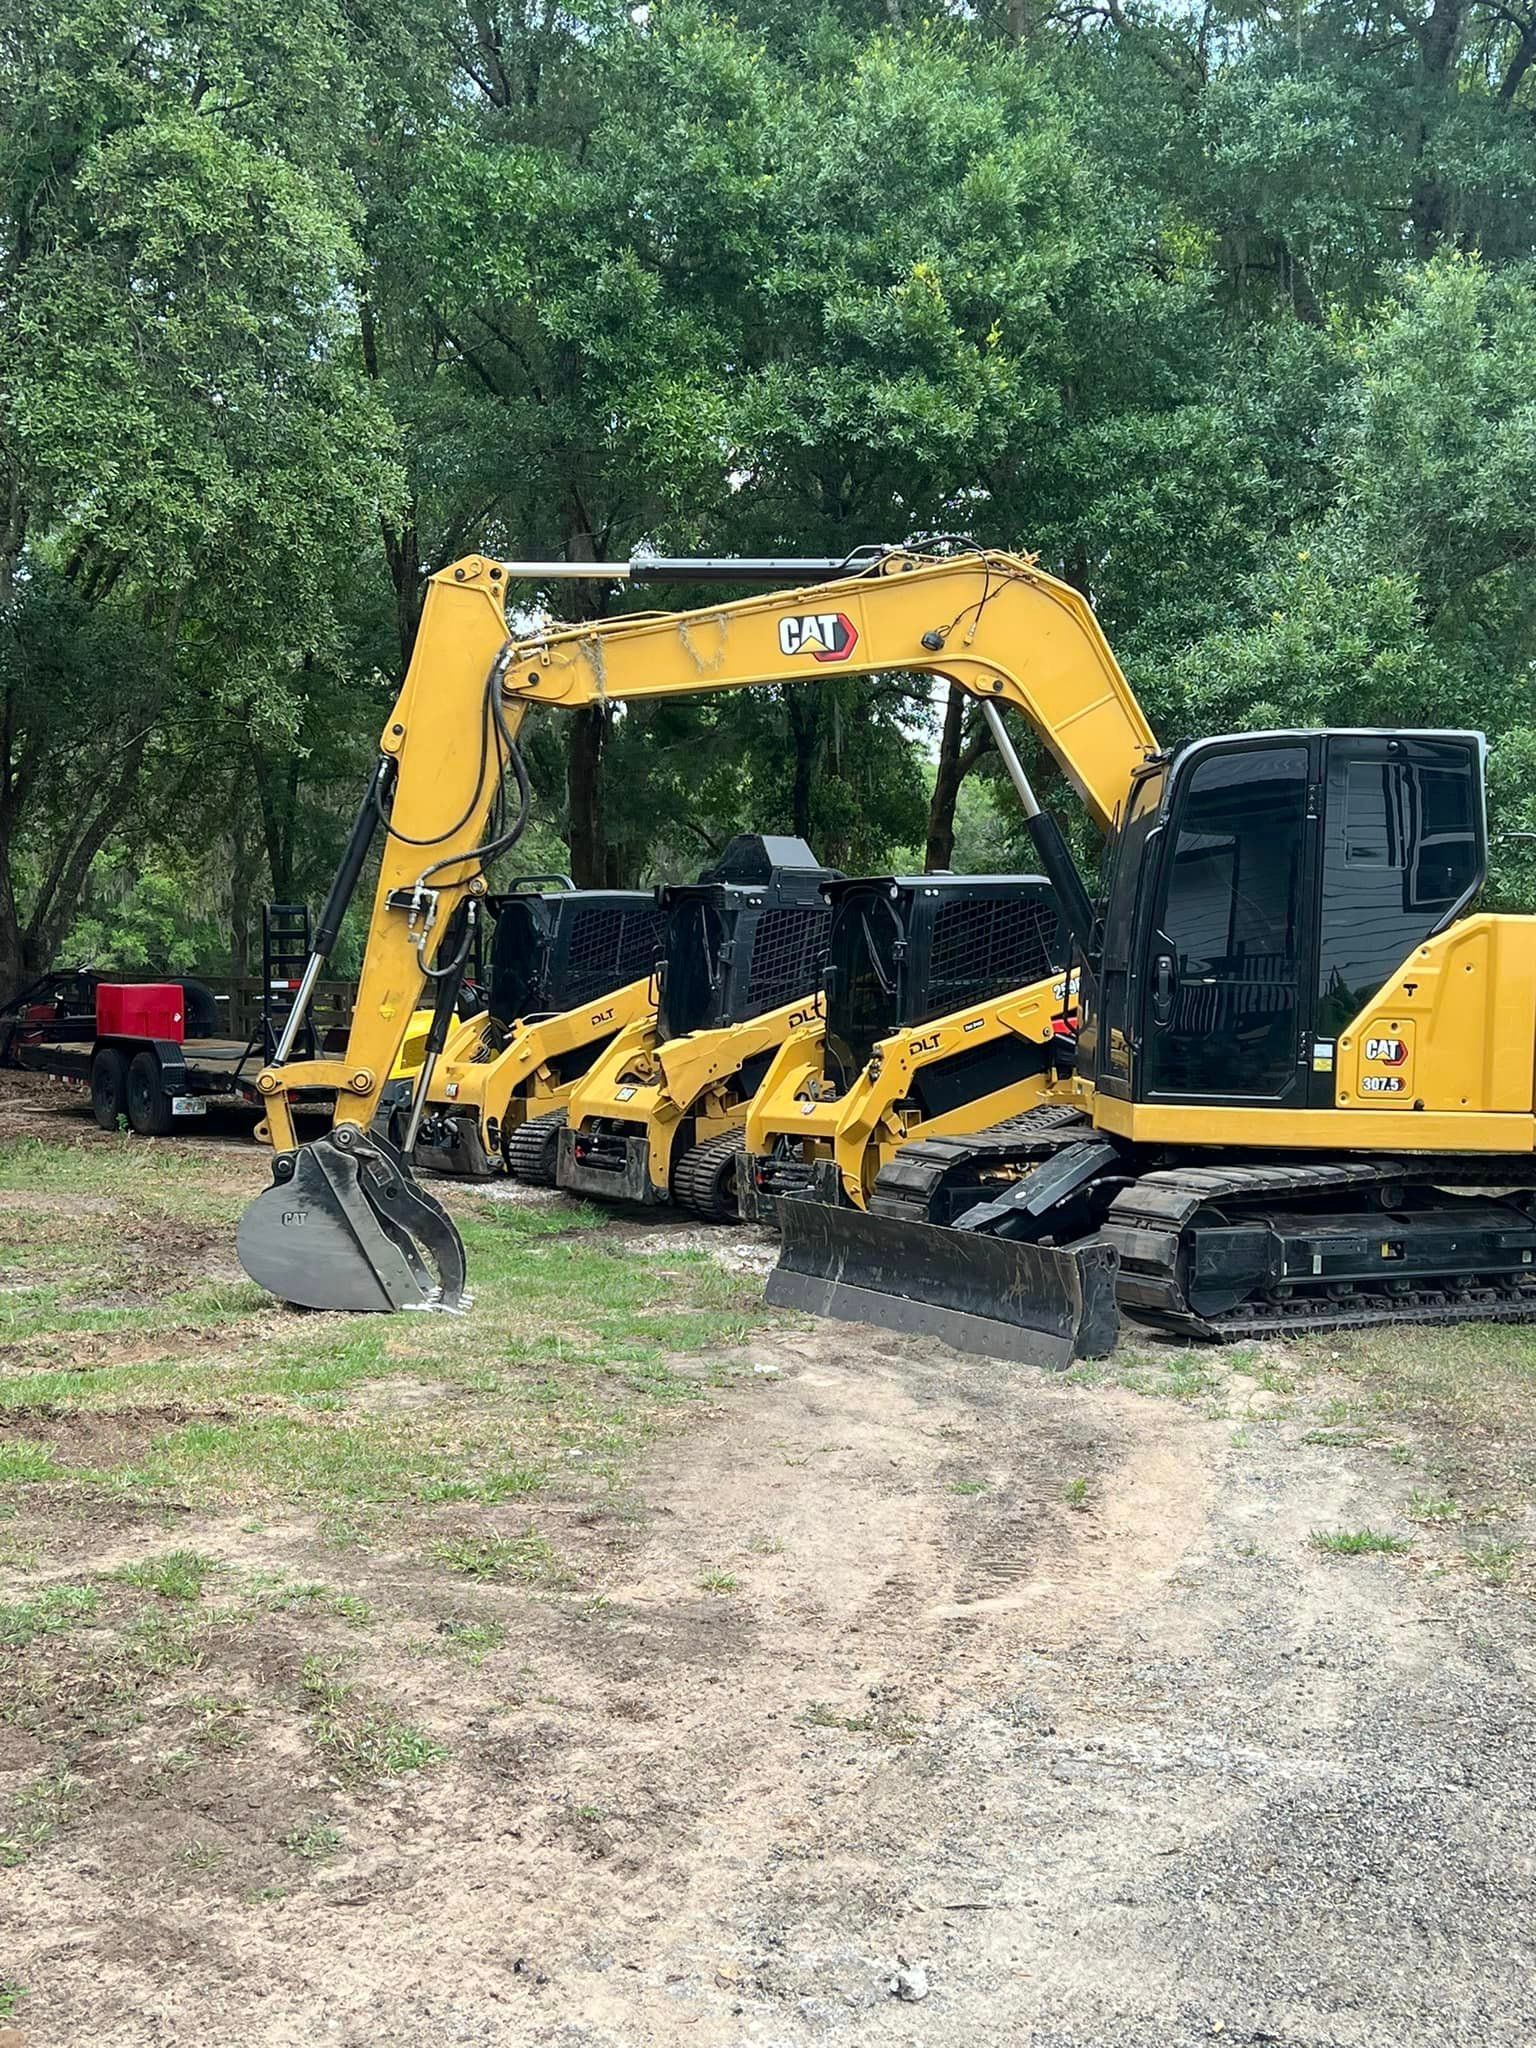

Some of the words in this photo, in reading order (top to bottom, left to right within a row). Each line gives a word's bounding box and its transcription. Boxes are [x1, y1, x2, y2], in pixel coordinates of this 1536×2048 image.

[779, 614, 838, 655] CAT
[592, 1008, 614, 1026] DLT
[789, 1002, 822, 1028] DLT
[909, 1033, 941, 1056] DLT
[1366, 1039, 1400, 1060] CAT
[1363, 1077, 1400, 1090] 307.5
[281, 1212, 308, 1226] CAT
